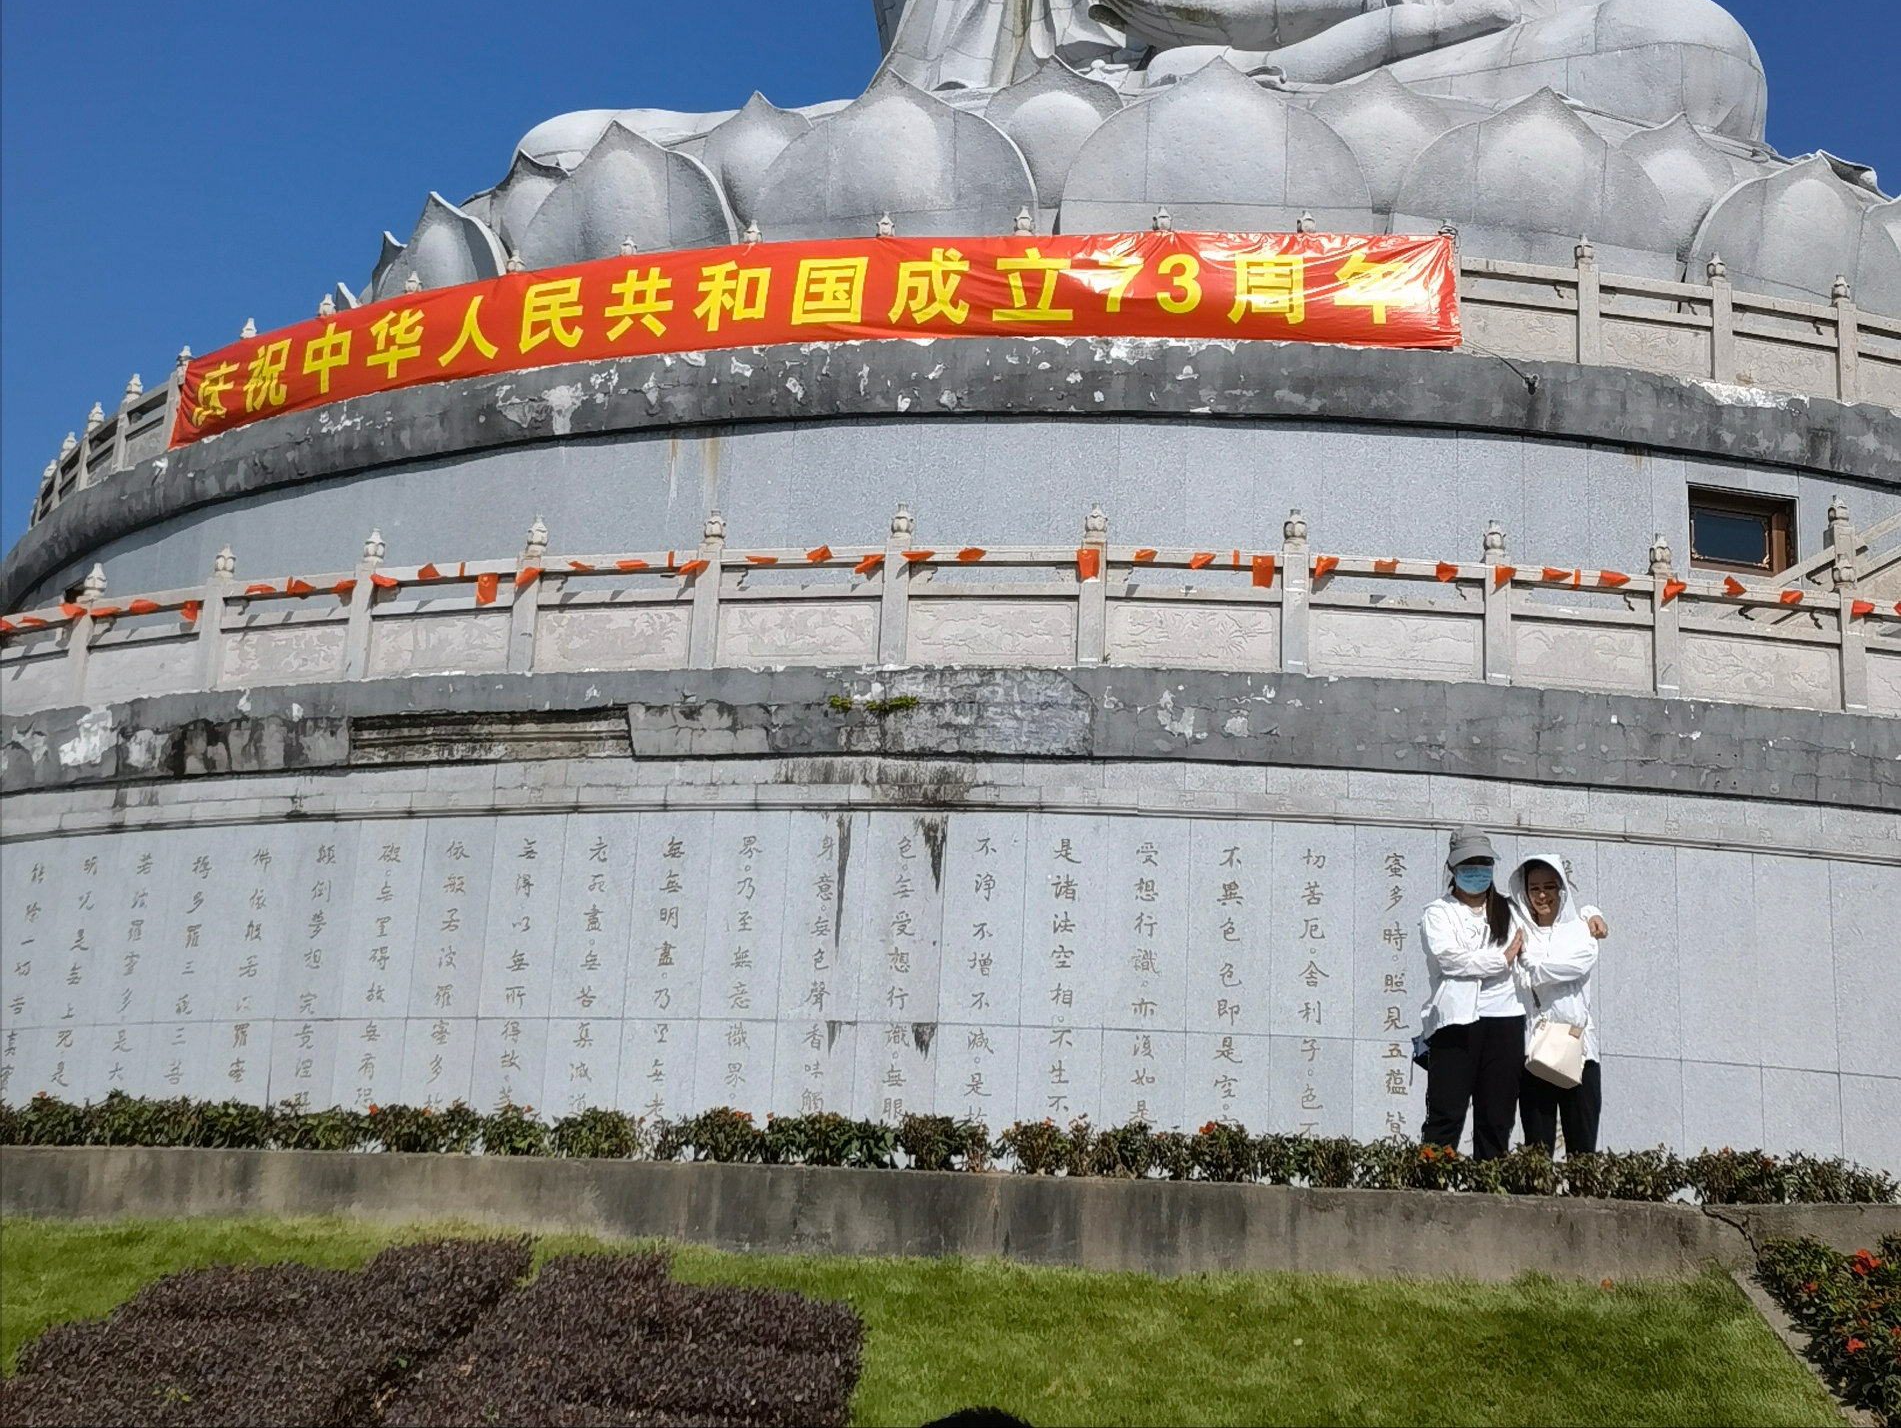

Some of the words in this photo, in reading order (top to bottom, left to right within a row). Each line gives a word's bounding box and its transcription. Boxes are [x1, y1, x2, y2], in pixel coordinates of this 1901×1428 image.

[192, 247, 1415, 426] 庆祝中华人民共和国成立73周年
